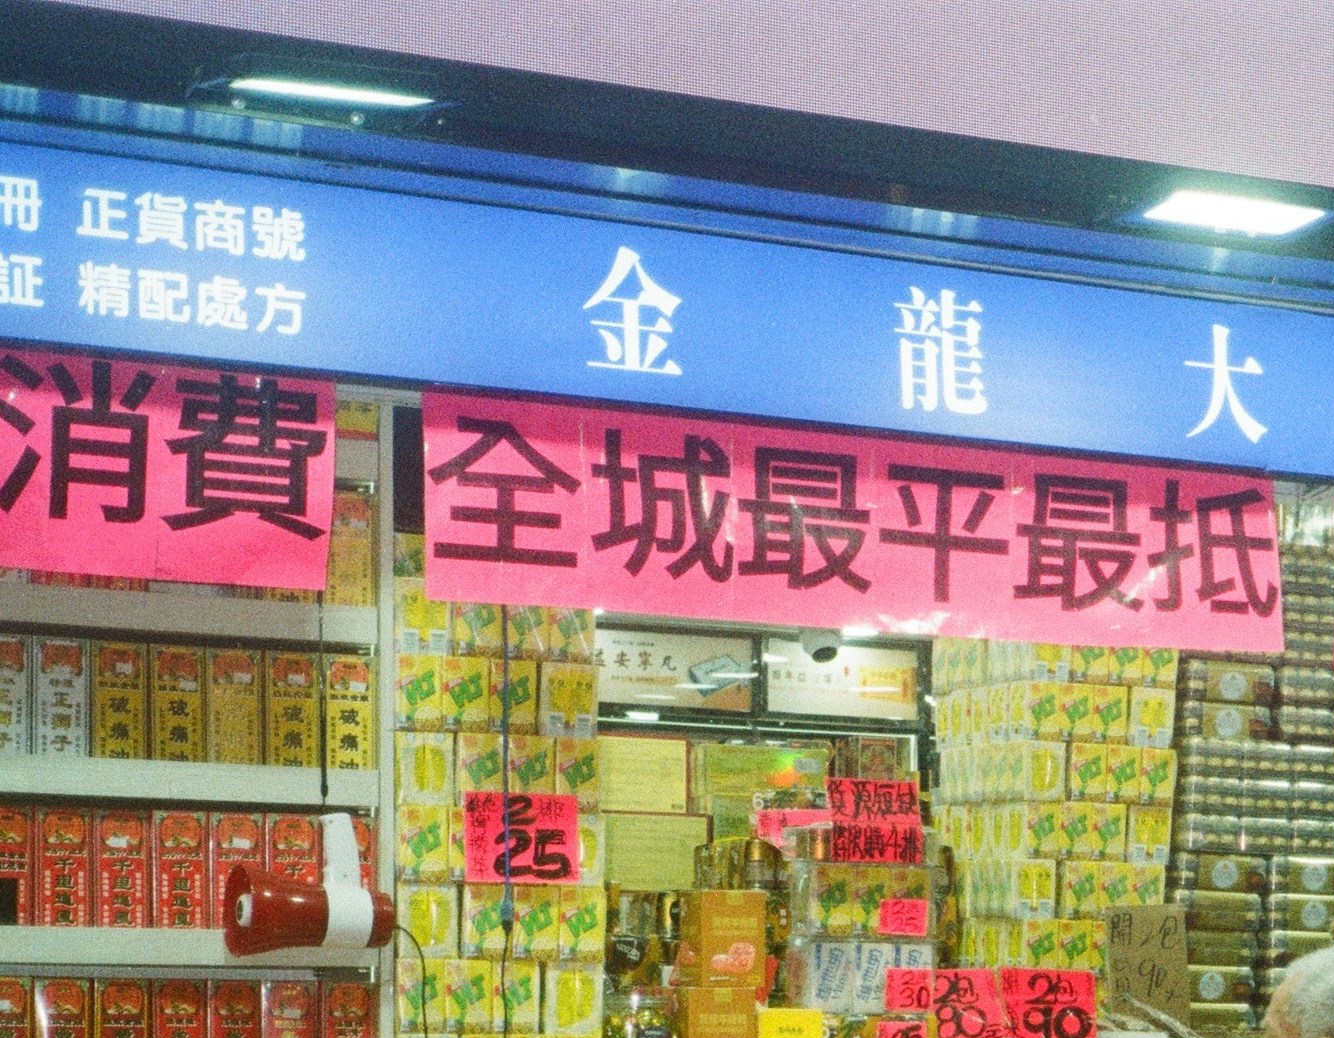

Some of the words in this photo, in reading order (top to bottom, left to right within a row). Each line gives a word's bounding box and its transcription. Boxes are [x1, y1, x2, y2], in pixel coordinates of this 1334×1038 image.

[76, 186, 307, 260] 正貨商號
[78, 261, 307, 336] 精配處方
[0, 352, 327, 541] 消費
[428, 416, 1279, 618] 全城最平最抵
[494, 828, 572, 880] 25
